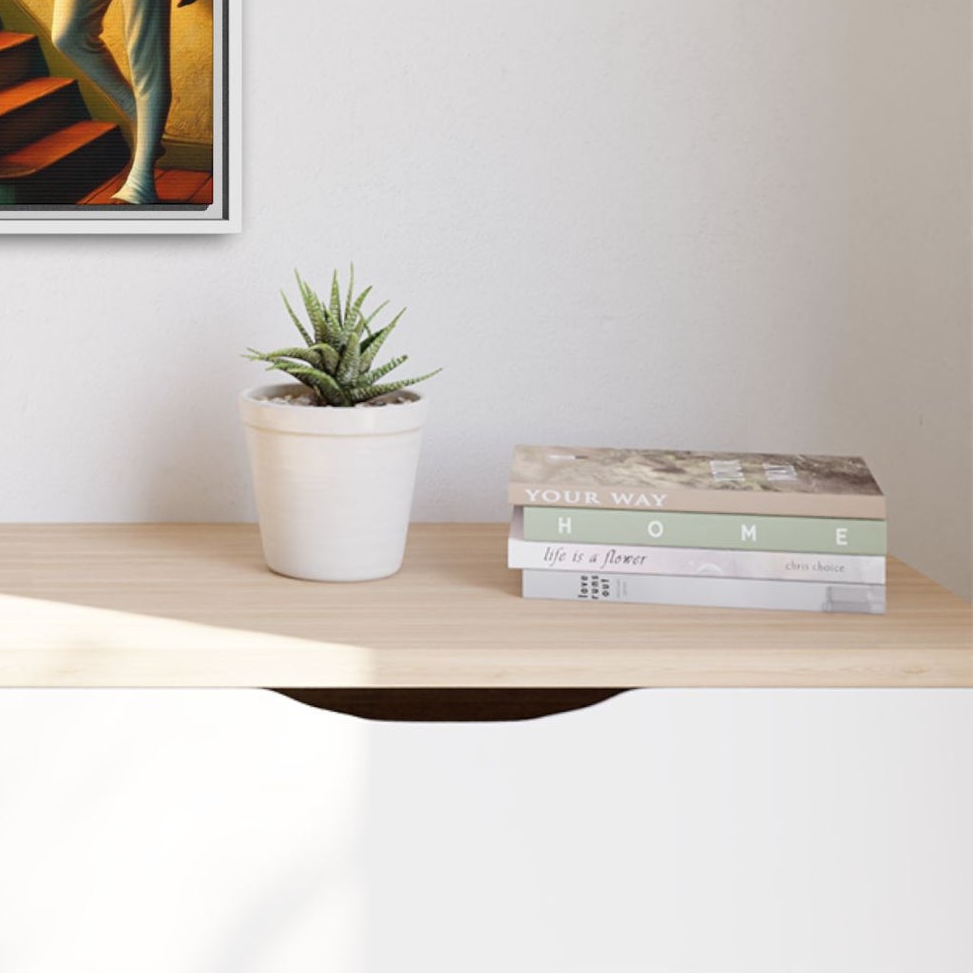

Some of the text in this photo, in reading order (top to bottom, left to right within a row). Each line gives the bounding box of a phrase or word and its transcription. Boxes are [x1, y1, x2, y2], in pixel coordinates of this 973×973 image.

[525, 489, 667, 507] YOUR WAY
[543, 547, 648, 569] life is a flower
[785, 560, 845, 573] chris choice
[577, 575, 588, 598] love
[591, 575, 599, 599] runs
[601, 578, 610, 597] out
